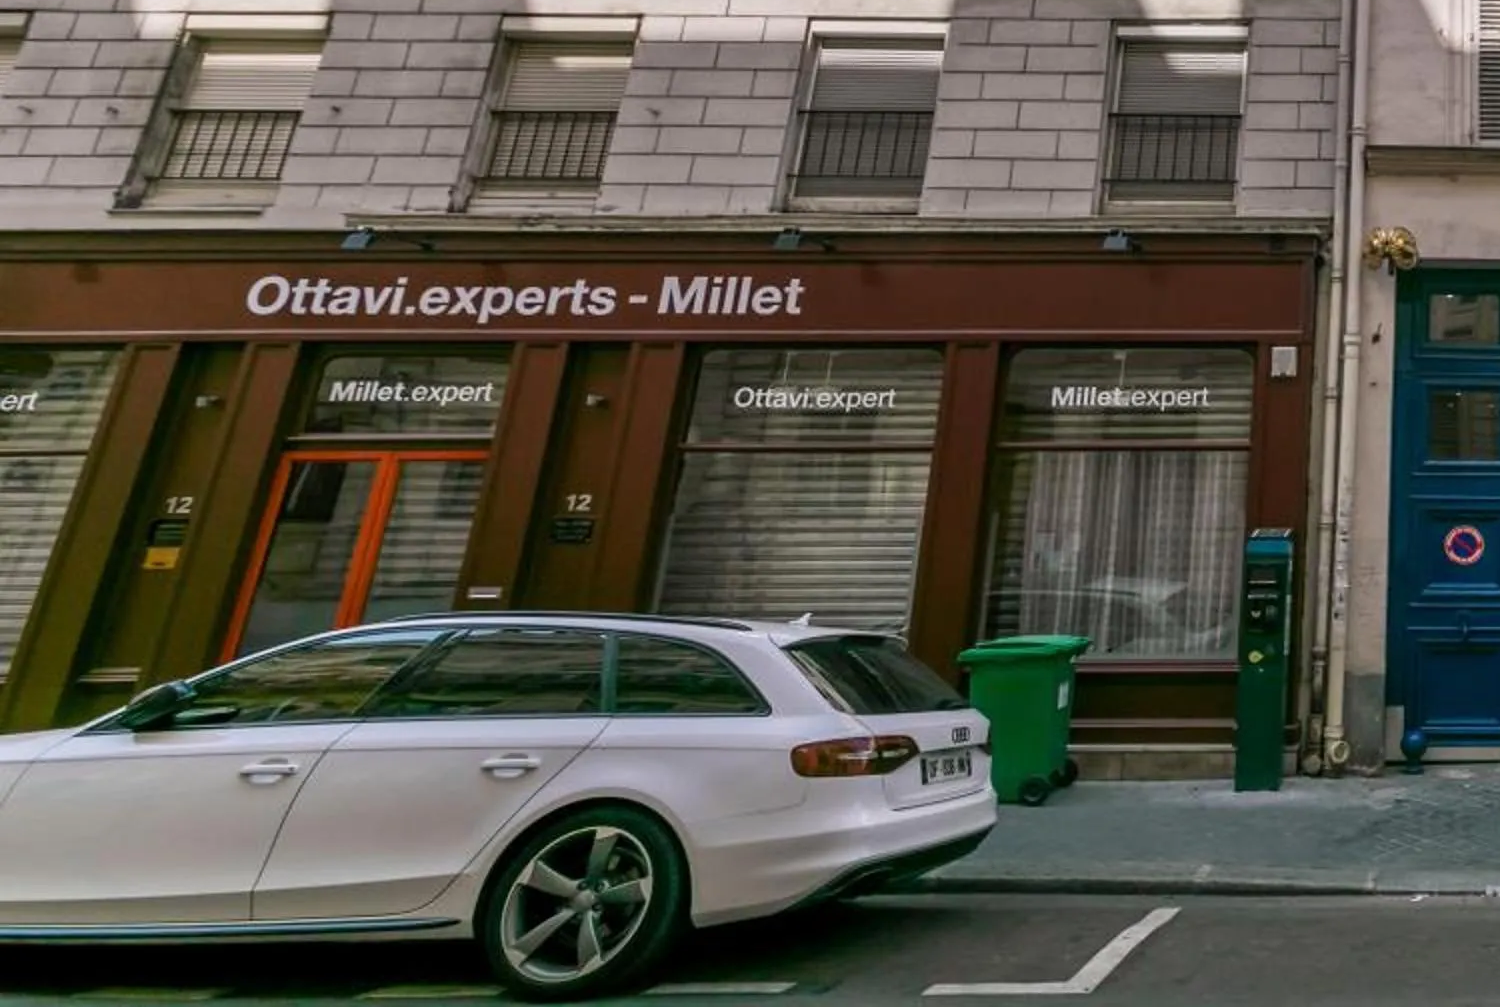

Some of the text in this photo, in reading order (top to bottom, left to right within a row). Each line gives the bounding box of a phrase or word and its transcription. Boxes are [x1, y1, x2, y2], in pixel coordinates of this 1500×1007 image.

[246, 275, 617, 324] Ottavi.experts
[657, 276, 805, 316] Millet
[328, 381, 494, 406] Millet.expert
[733, 386, 897, 413] Ottavi.expert
[1050, 386, 1210, 411] Millet.expert
[165, 496, 193, 514] 12
[566, 494, 593, 512] 12
